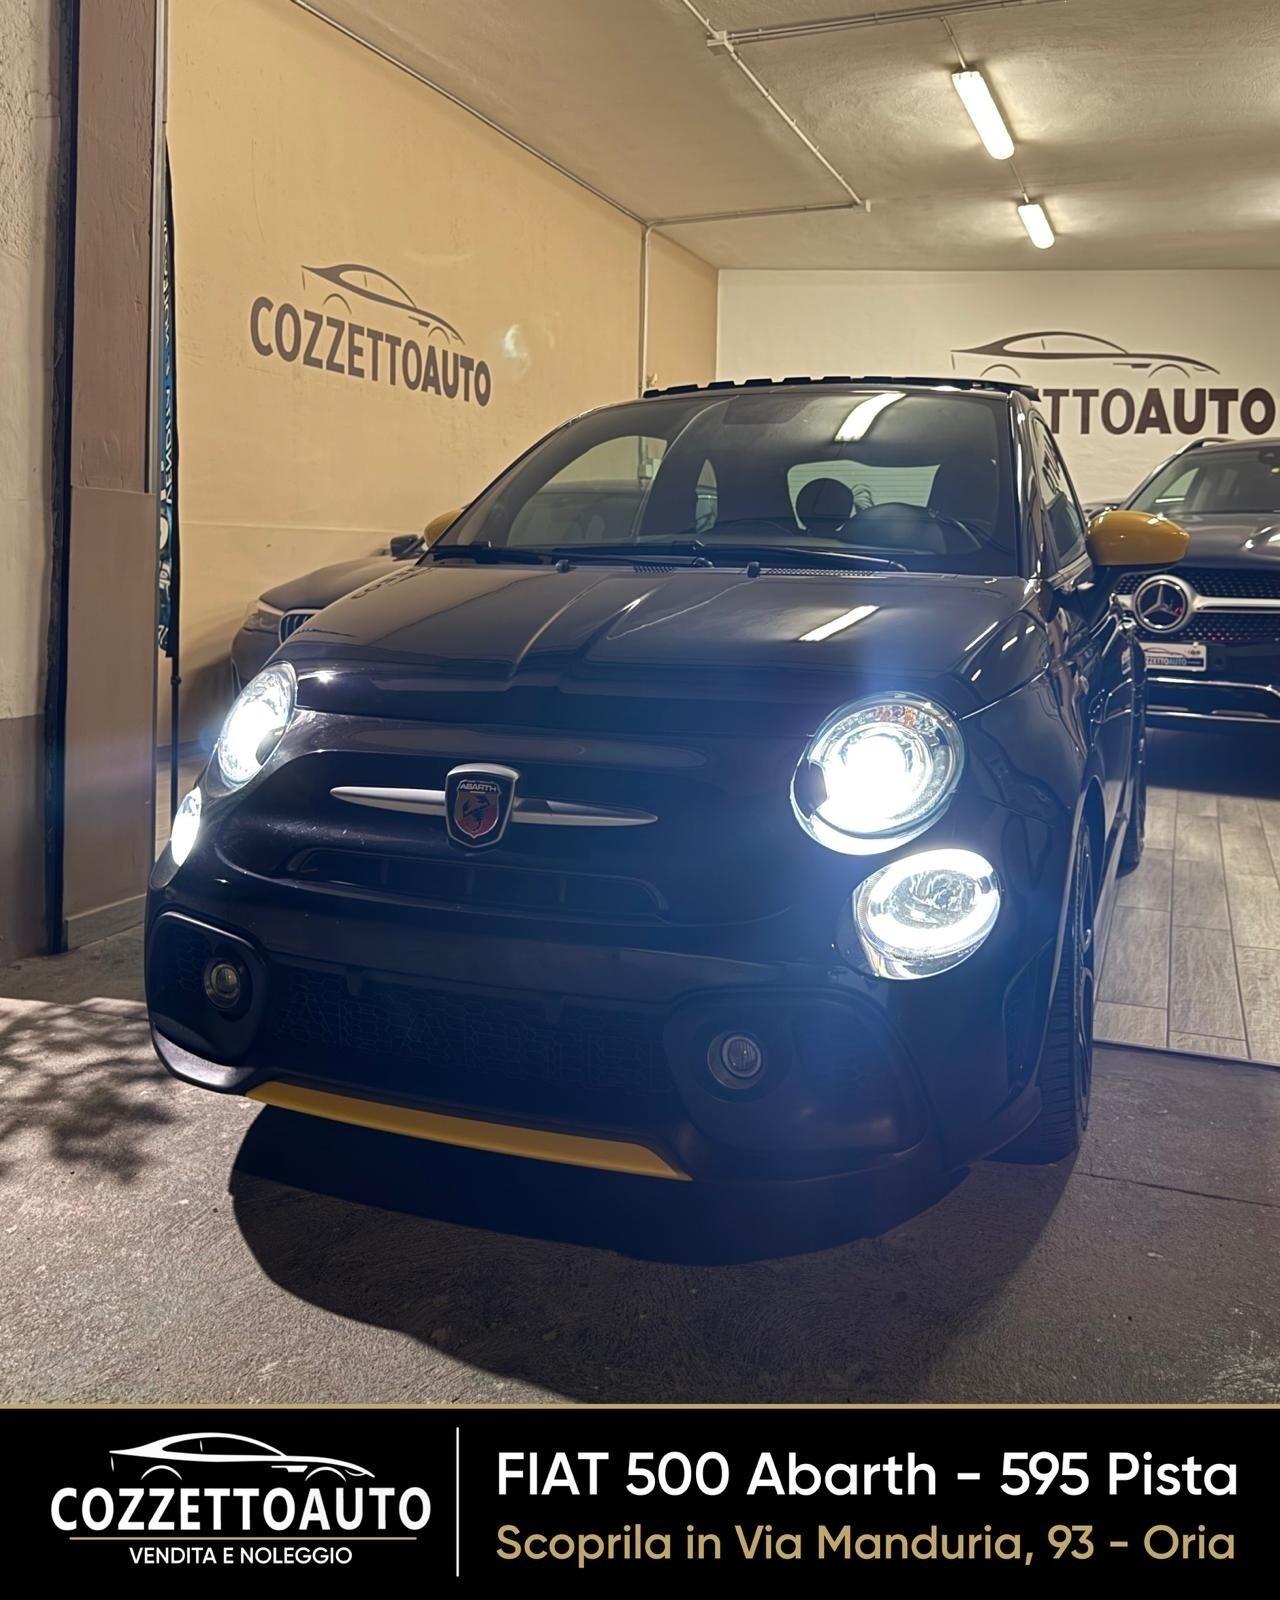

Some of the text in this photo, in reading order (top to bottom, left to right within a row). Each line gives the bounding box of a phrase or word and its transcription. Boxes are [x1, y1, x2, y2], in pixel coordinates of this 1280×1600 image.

[250, 296, 492, 407] COZZETTOAUTO
[1035, 388, 1276, 435] TTOAUTO
[461, 784, 497, 792] ABARTH
